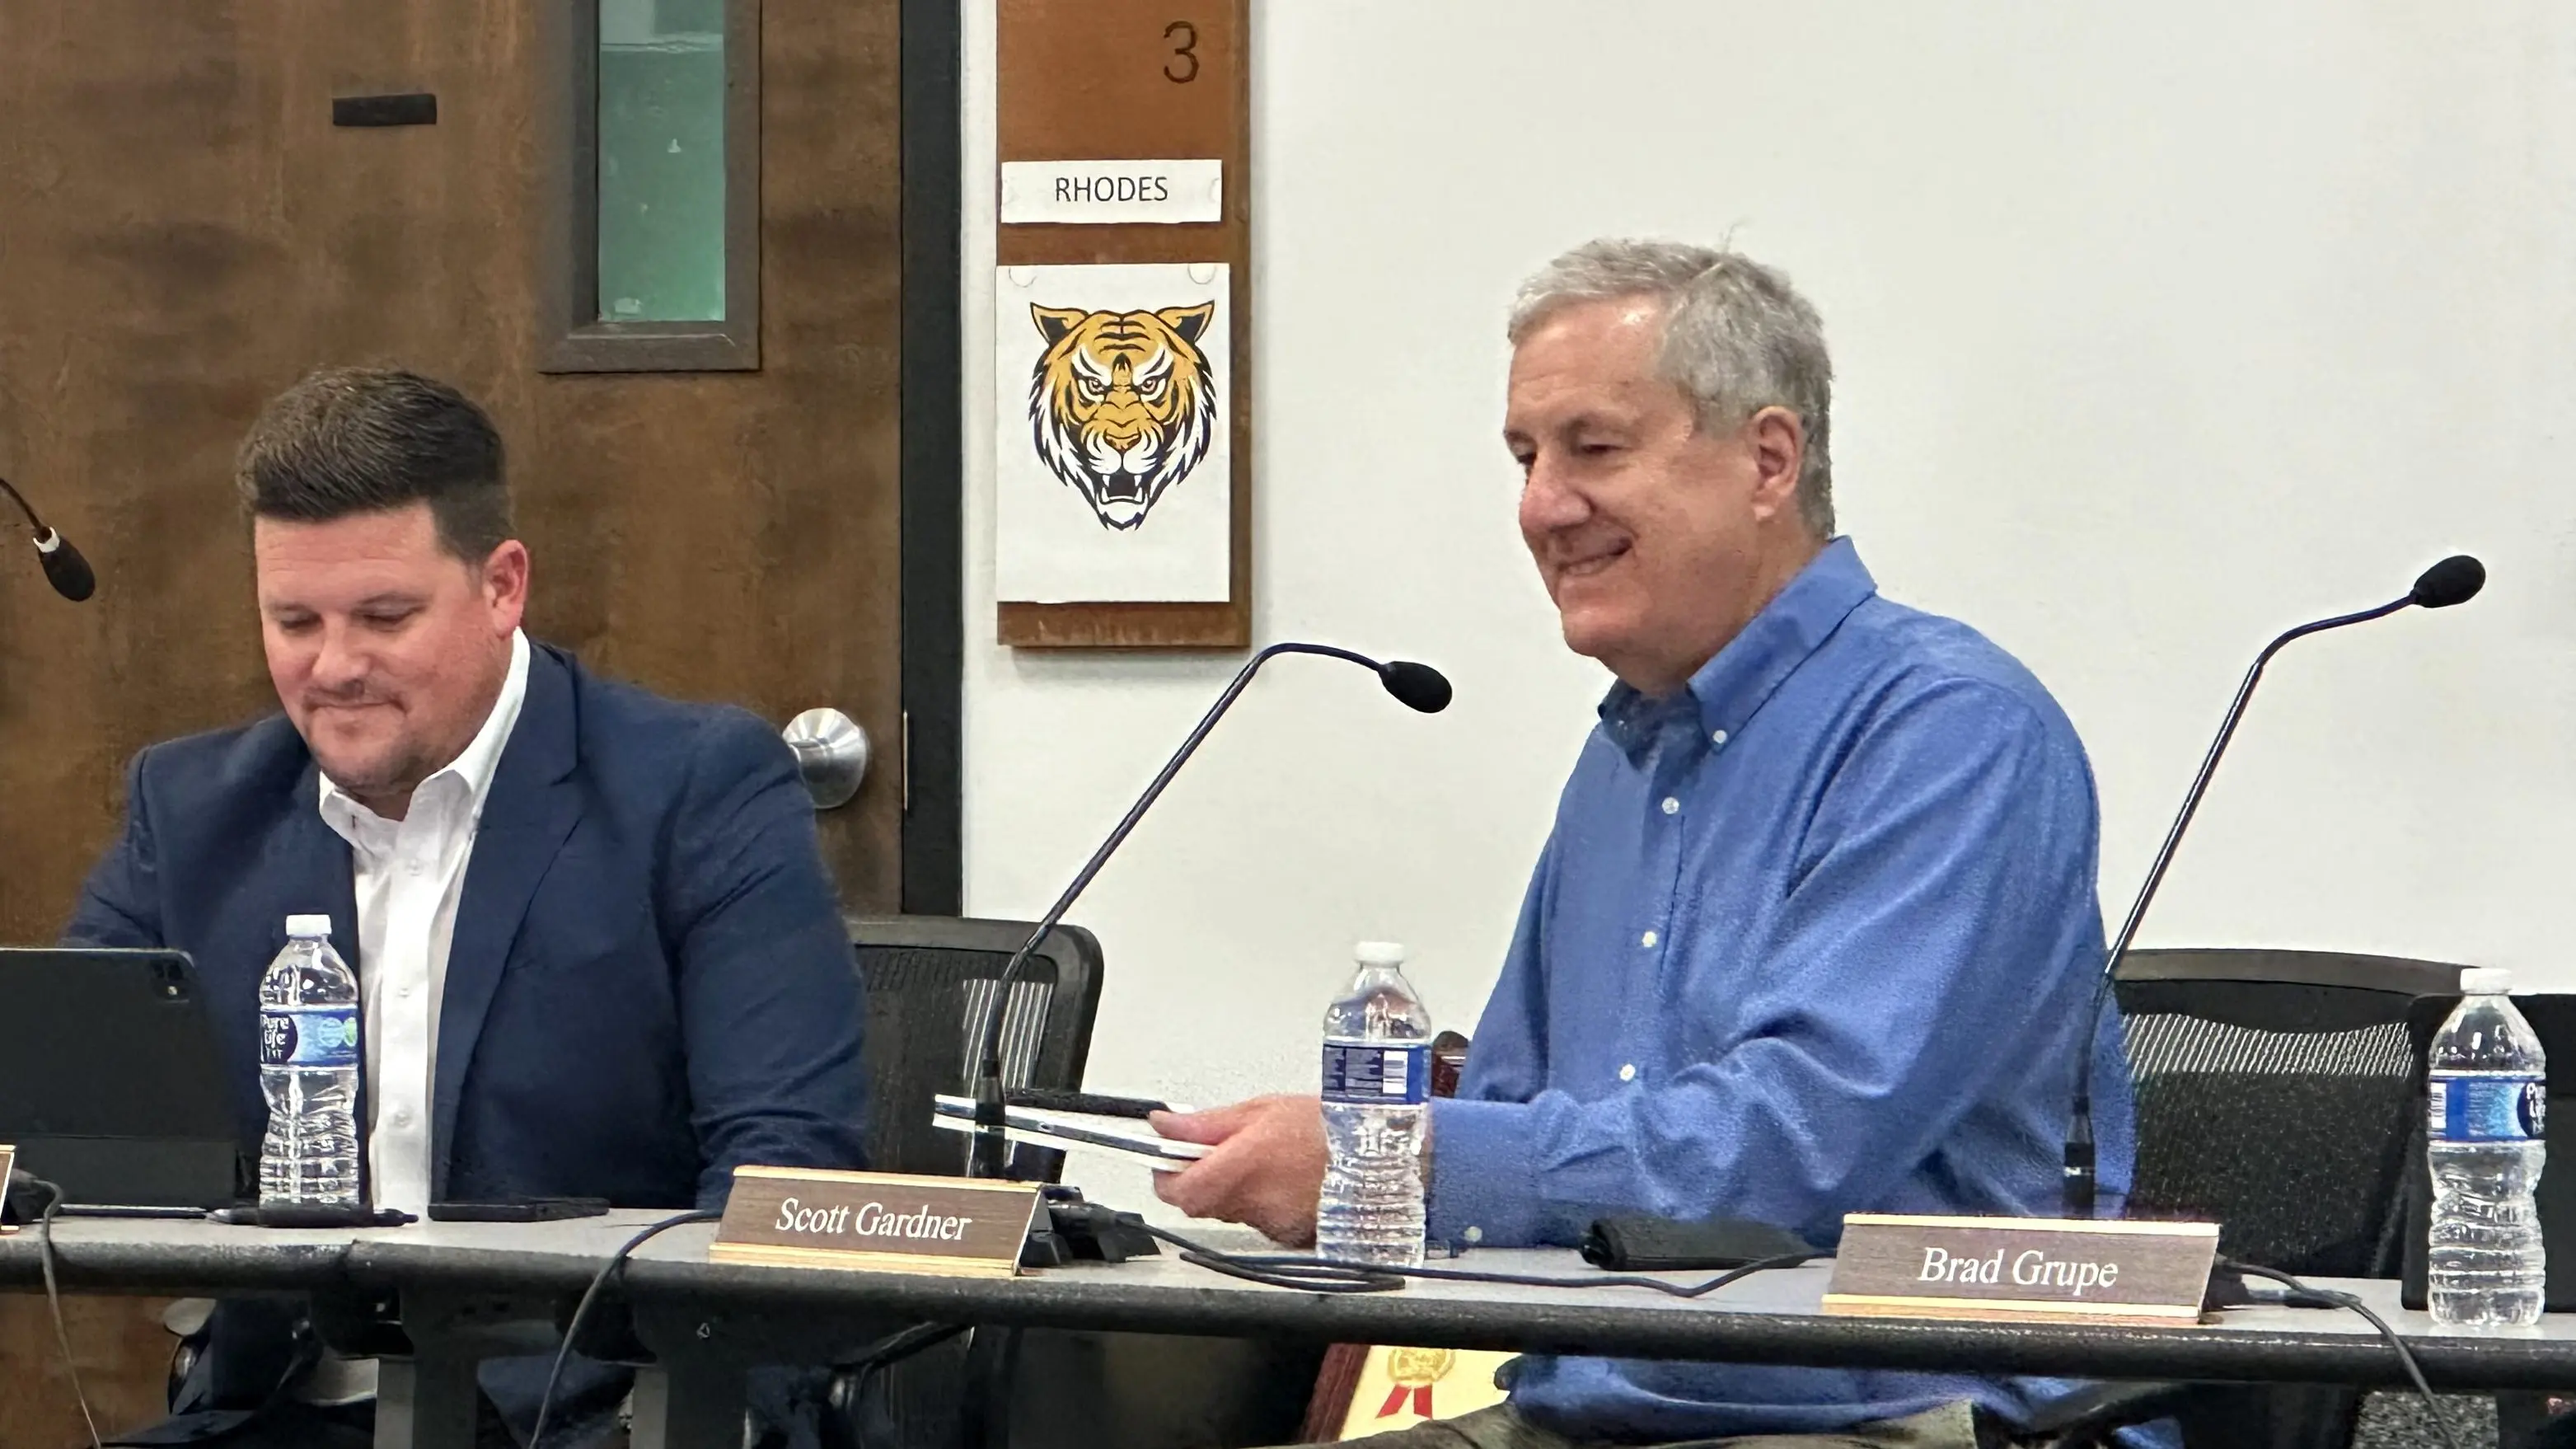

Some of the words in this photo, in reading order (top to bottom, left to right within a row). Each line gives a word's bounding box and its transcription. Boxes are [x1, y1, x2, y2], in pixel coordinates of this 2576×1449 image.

[1164, 21, 1199, 83] 3
[1056, 176, 1168, 202] RHODES
[775, 1197, 849, 1234] Scott
[855, 1202, 972, 1240] Gardner
[1918, 1246, 2005, 1284] Brad
[2012, 1250, 2119, 1296] Grupe
